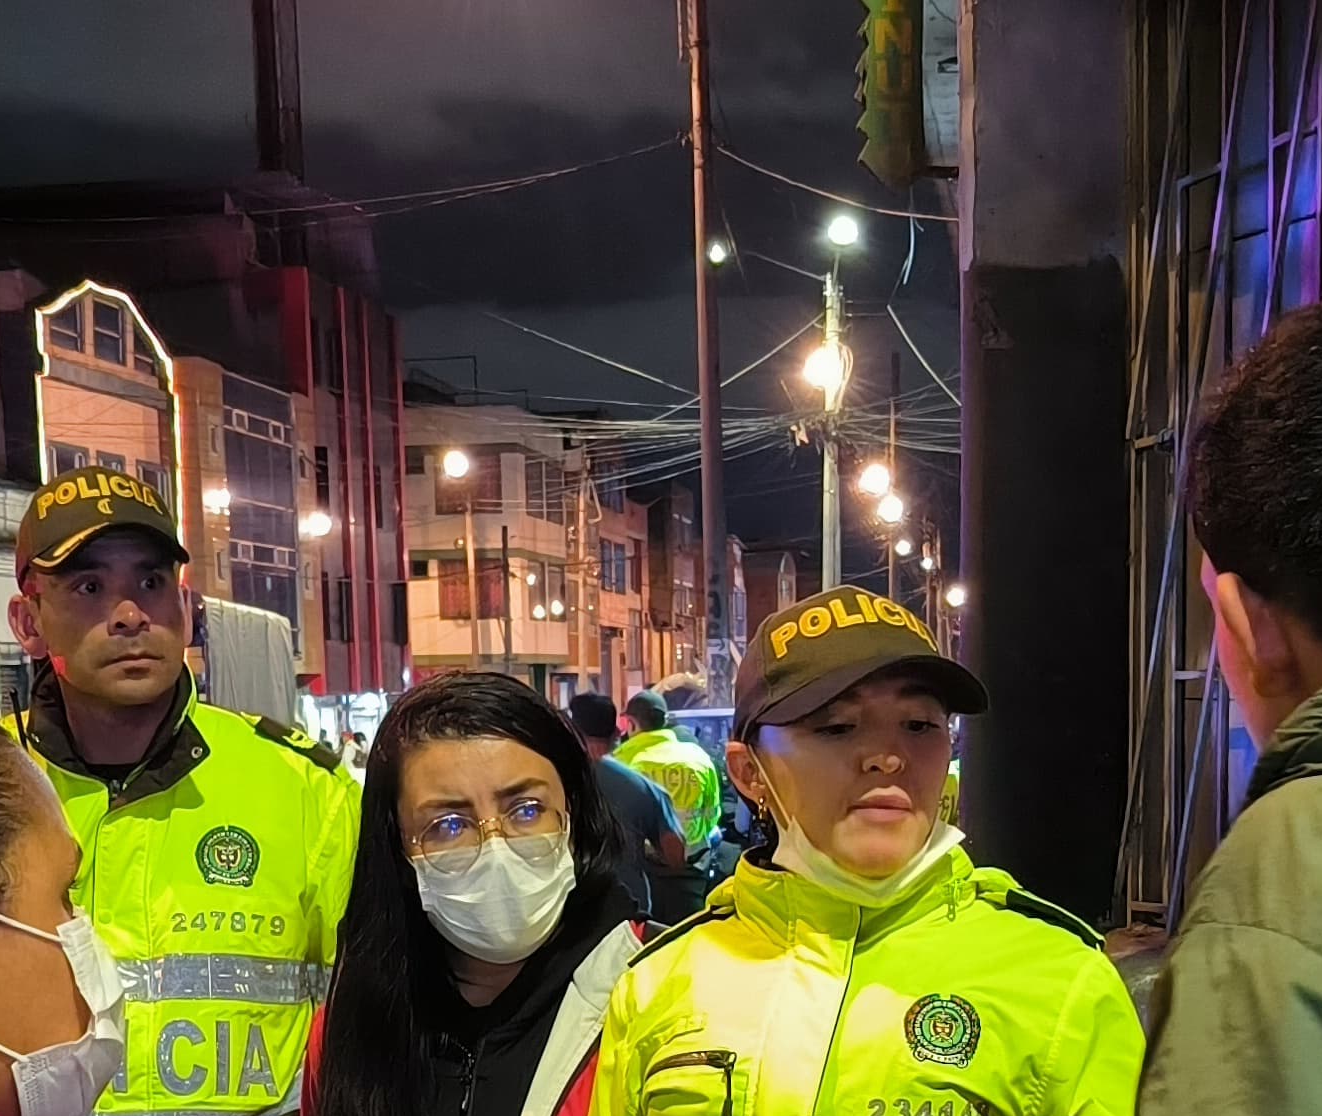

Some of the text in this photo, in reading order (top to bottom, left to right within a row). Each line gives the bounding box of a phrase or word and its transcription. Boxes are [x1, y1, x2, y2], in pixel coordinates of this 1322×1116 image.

[36, 473, 164, 520] POLICIA
[770, 594, 938, 659] POLICIA
[171, 912, 285, 936] 247879
